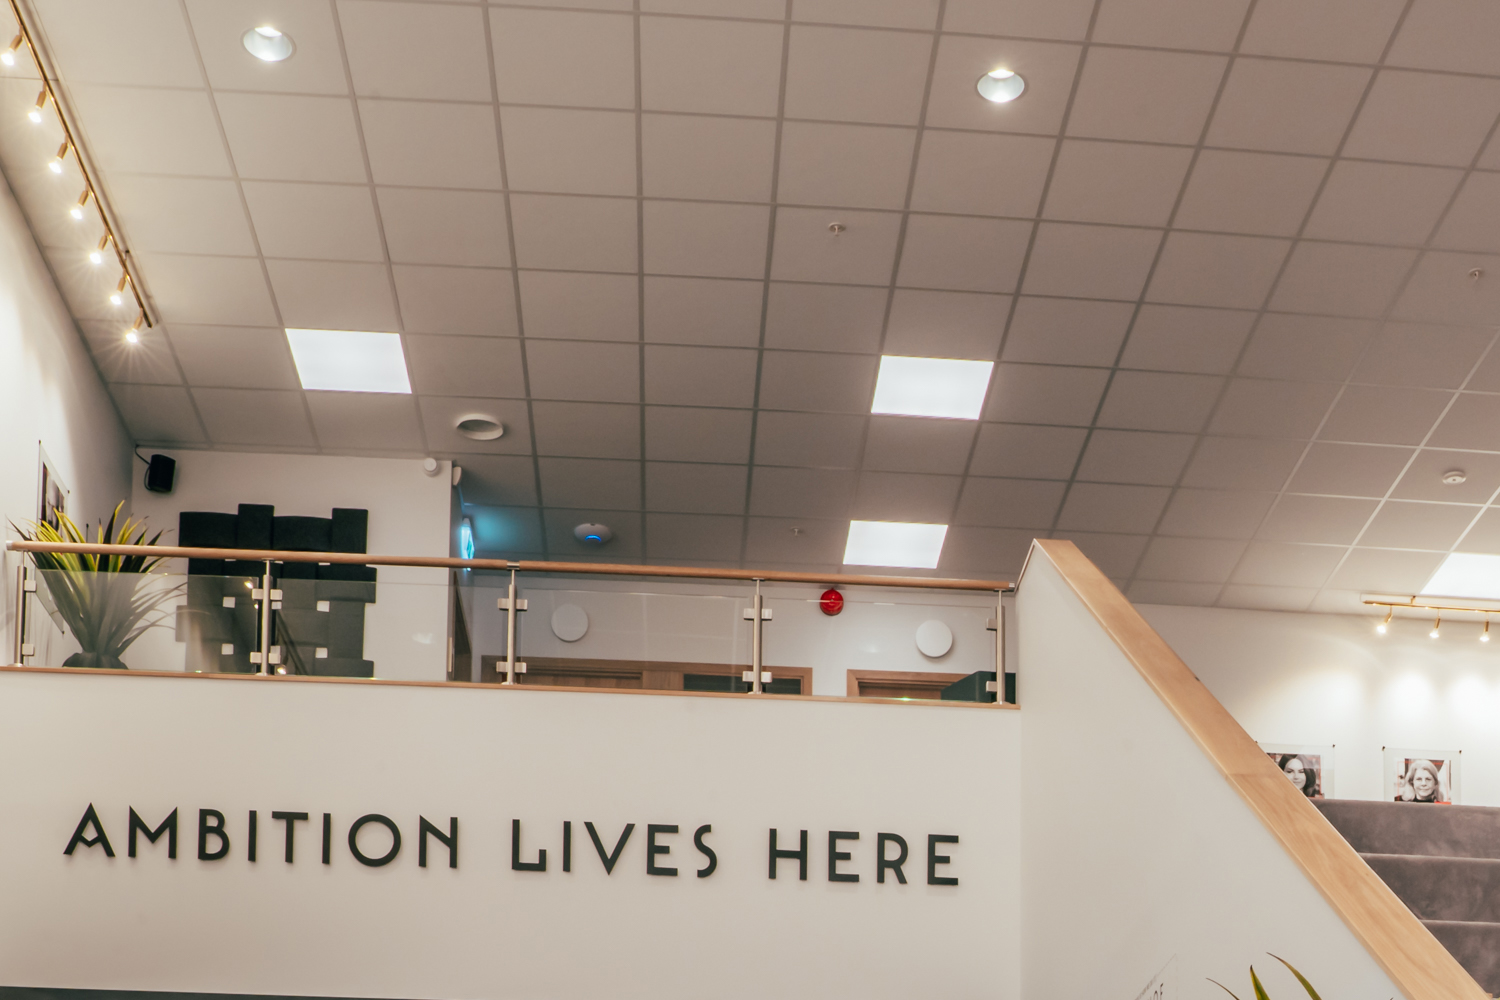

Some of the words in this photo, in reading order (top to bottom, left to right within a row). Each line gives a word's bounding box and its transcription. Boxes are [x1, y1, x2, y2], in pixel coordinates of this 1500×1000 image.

[62, 802, 459, 870] AMBITION
[511, 818, 719, 879] LIVES
[768, 828, 960, 887] HERE
